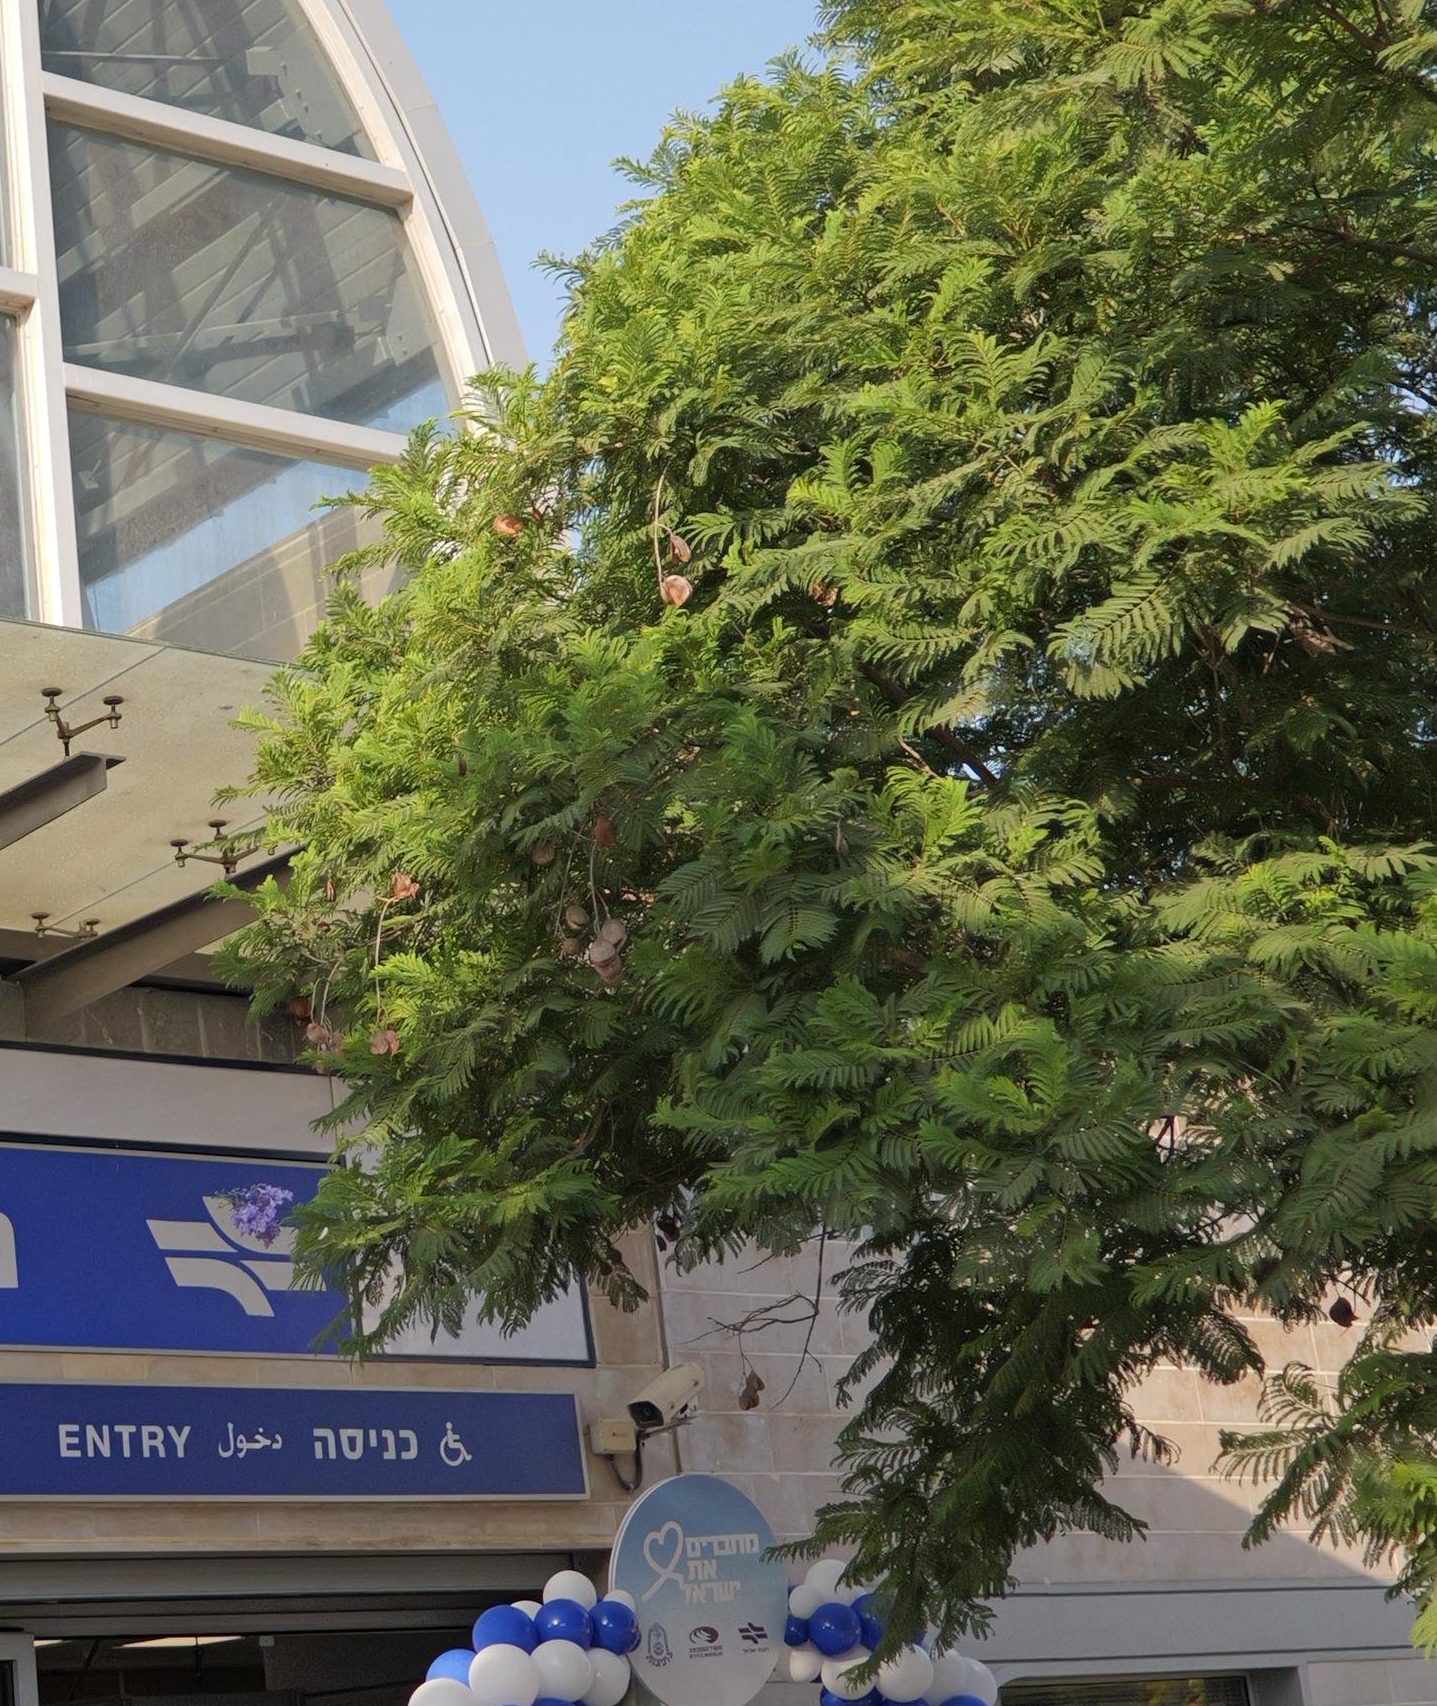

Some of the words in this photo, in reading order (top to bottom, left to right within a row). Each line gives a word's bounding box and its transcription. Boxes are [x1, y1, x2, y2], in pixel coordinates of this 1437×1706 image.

[58, 1424, 191, 1458] ENTRY
[217, 1421, 283, 1459] دخول
[313, 1428, 418, 1461] כניסה
[688, 1558, 717, 1581] את
[679, 1580, 741, 1605] ישראל
